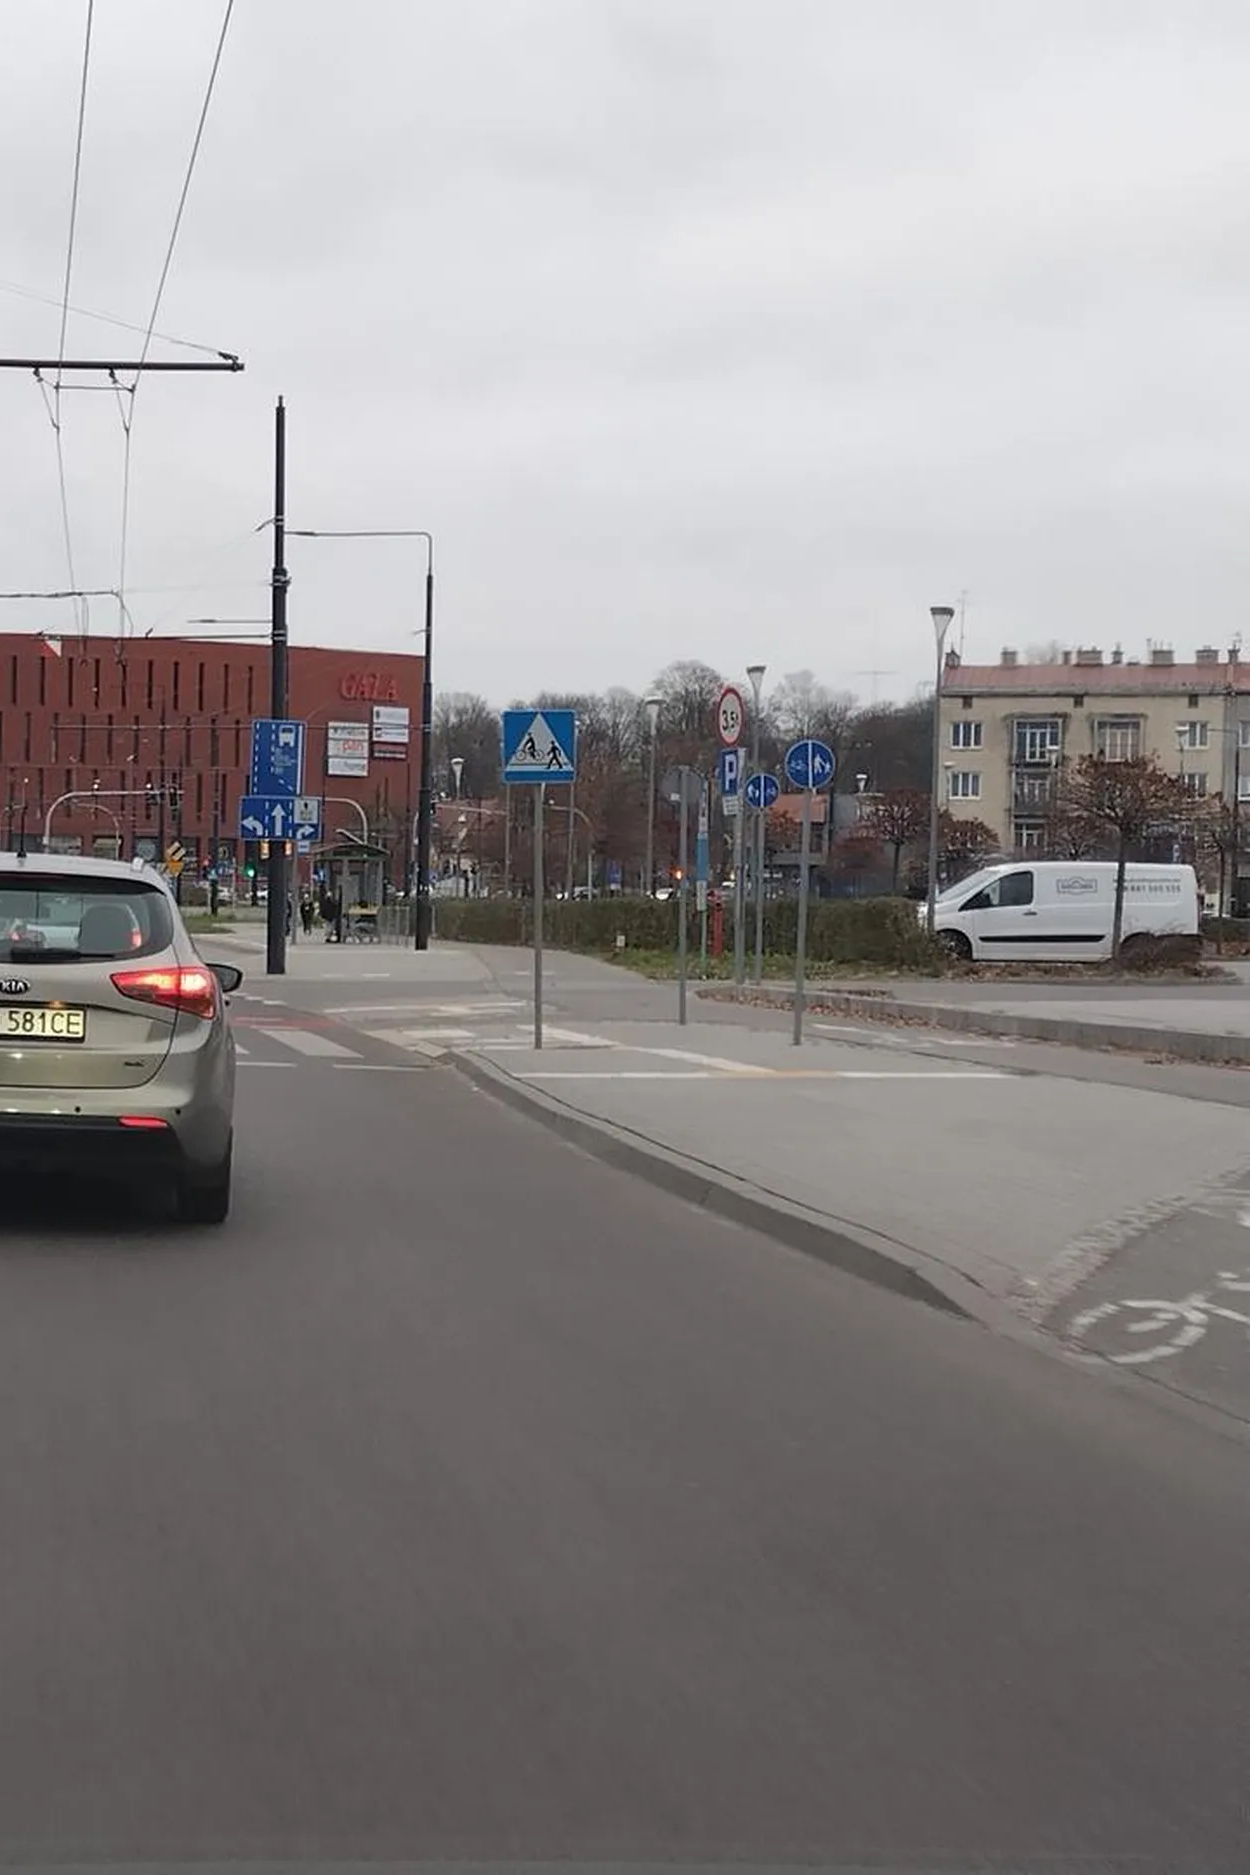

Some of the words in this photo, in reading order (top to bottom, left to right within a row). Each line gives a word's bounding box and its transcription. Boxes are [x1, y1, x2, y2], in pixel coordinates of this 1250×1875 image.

[725, 754, 738, 791] P
[0, 980, 26, 992] KIA
[8, 1010, 81, 1035] 581CE
